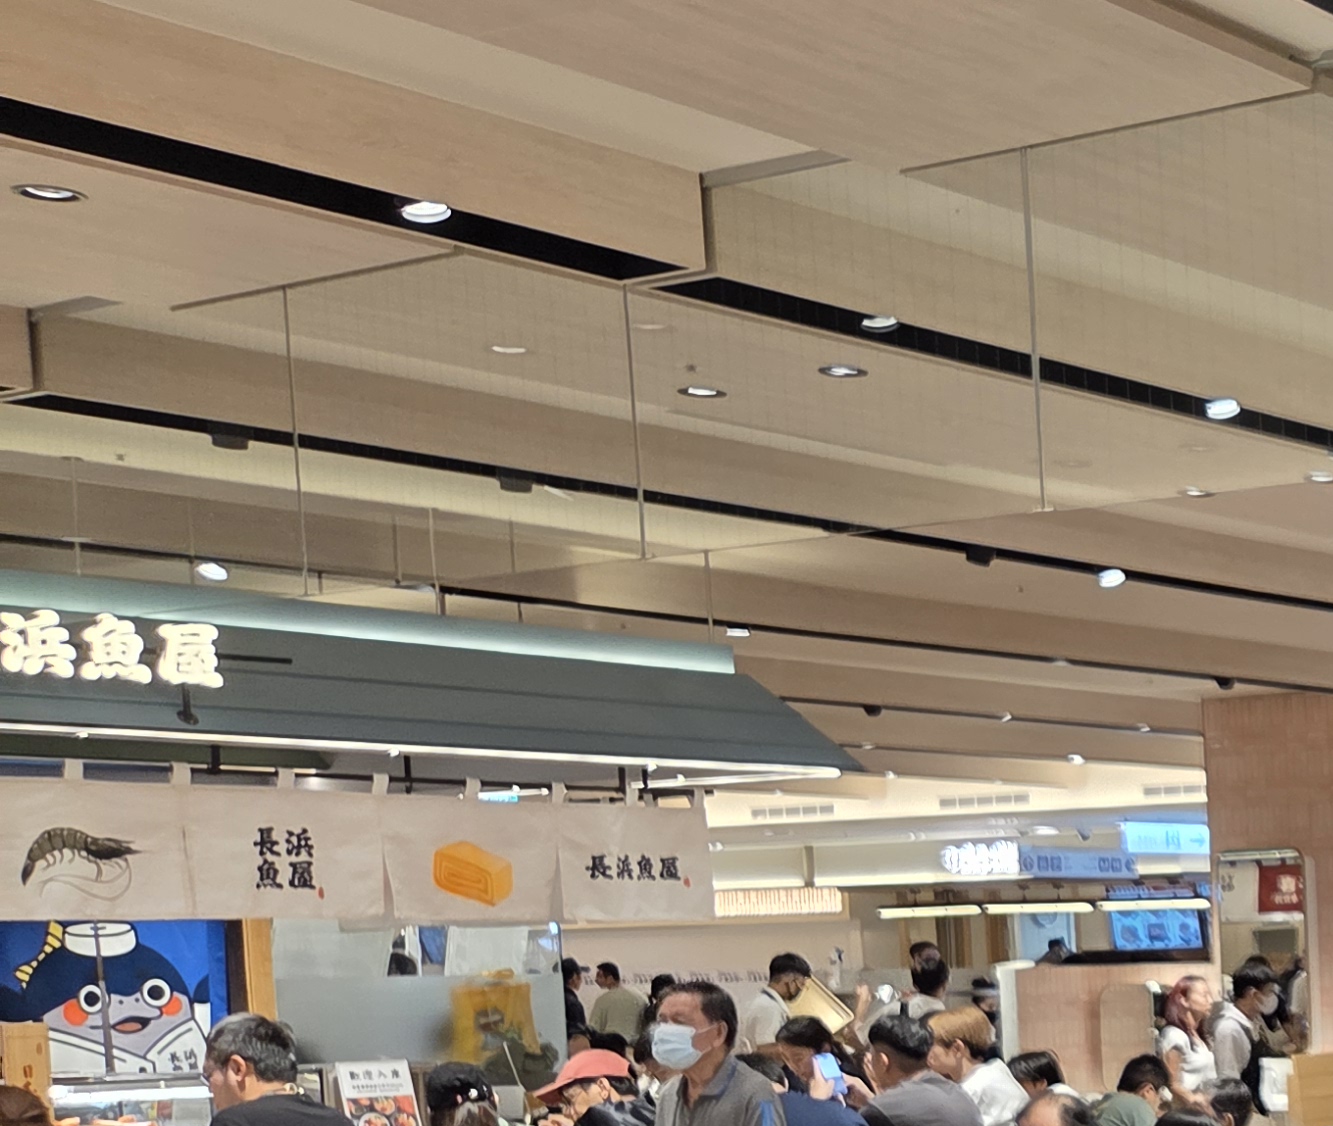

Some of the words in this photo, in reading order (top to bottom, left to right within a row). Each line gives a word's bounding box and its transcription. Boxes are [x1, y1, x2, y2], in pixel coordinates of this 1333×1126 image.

[253, 826, 314, 858] 長浜
[256, 857, 316, 890] 魚屋
[585, 853, 681, 881] 長浜魚屋
